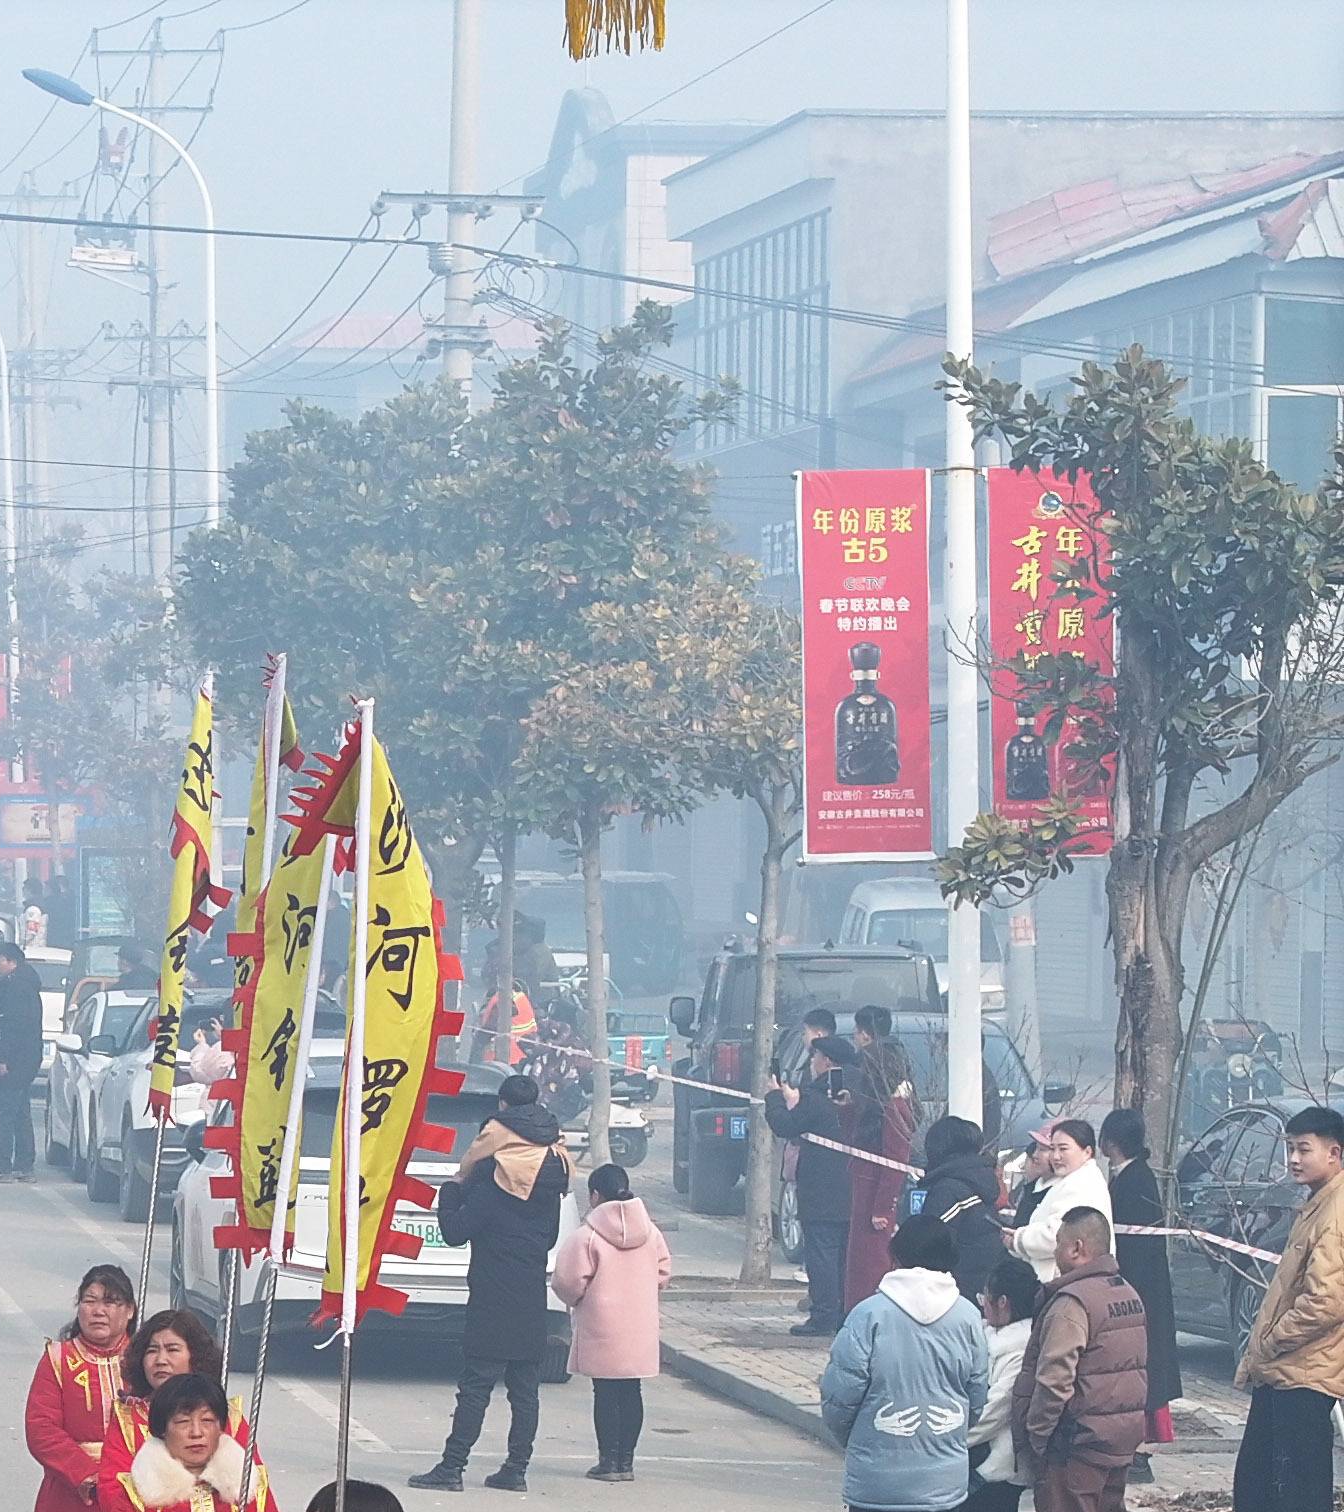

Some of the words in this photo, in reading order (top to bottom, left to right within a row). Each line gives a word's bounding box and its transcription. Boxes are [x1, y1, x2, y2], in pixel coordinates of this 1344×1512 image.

[812, 506, 914, 535] 年份原浆
[841, 537, 889, 564] 古5
[819, 596, 912, 614] 春节联欢晚会
[837, 616, 899, 632] 特约播出
